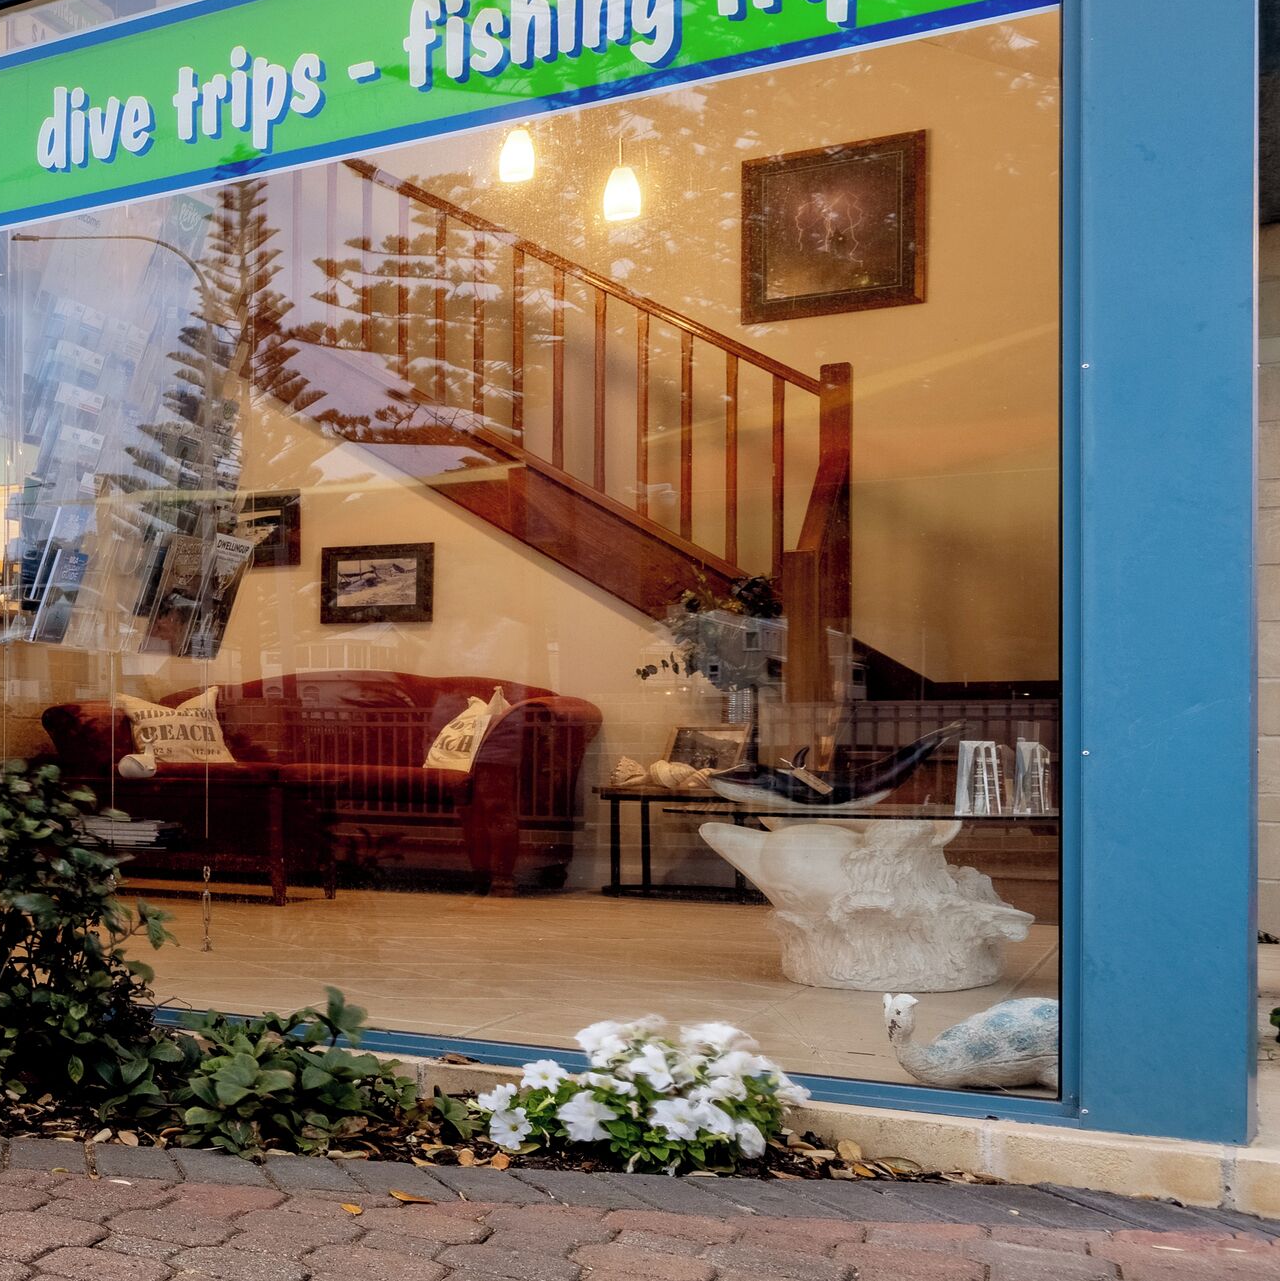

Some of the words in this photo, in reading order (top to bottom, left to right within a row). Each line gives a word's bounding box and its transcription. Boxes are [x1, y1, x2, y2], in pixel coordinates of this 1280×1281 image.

[37, 86, 154, 172] dive
[173, 45, 326, 151] trips
[140, 723, 217, 742] BEACH
